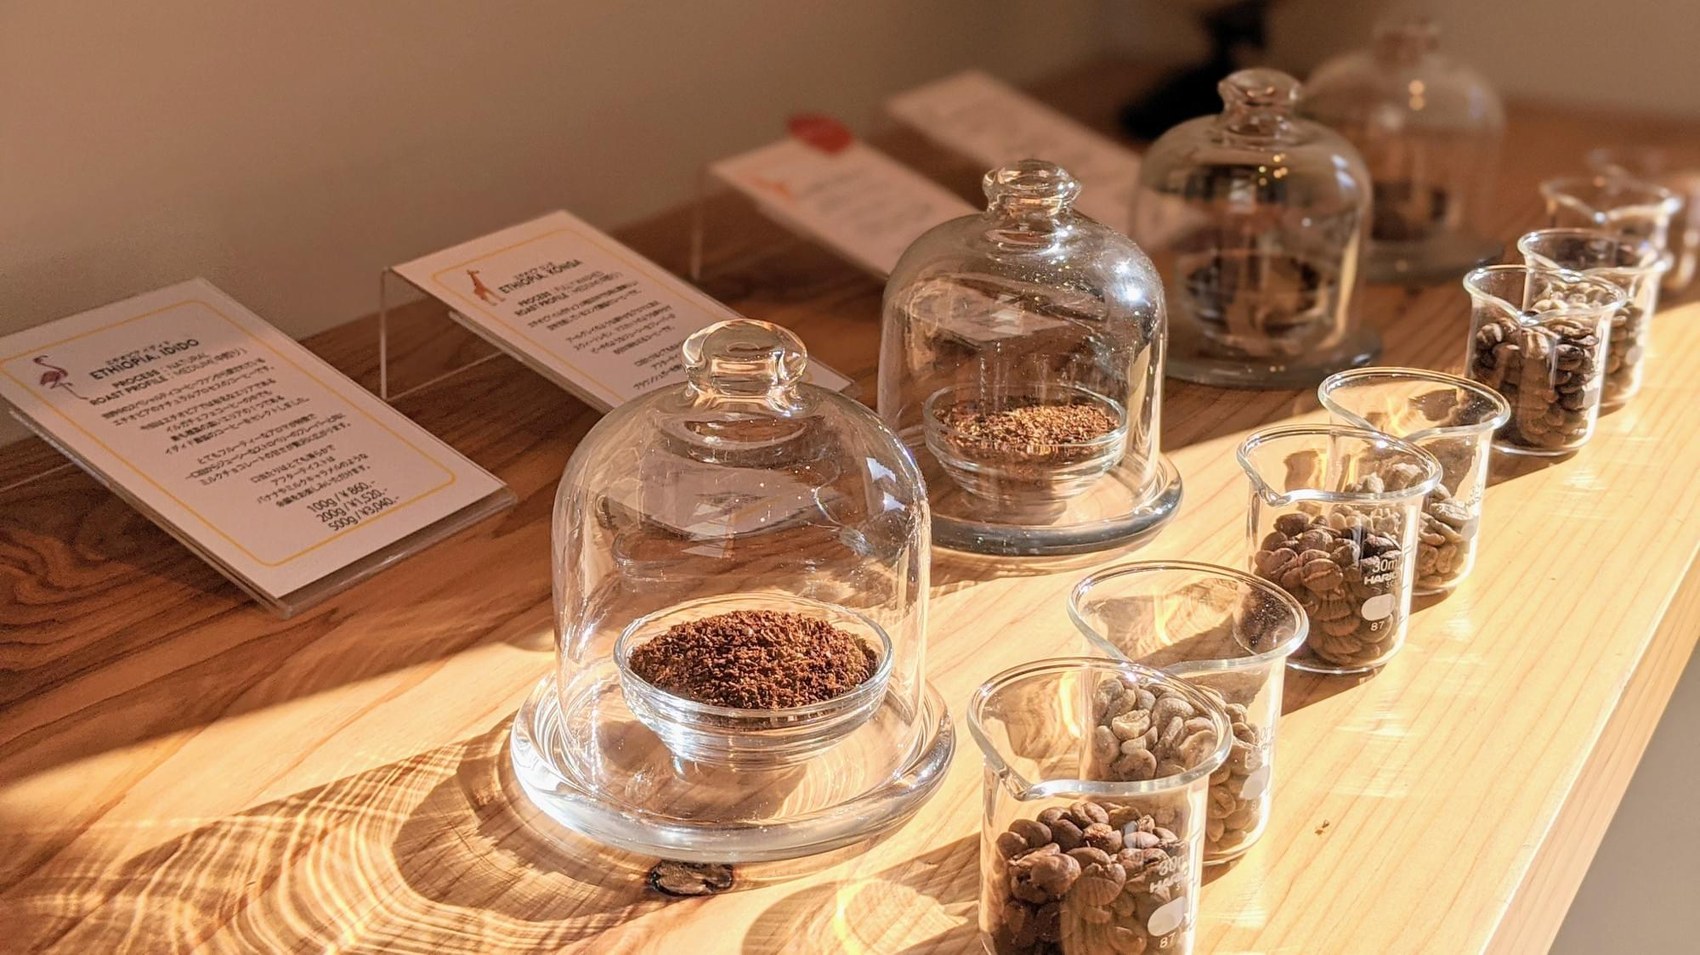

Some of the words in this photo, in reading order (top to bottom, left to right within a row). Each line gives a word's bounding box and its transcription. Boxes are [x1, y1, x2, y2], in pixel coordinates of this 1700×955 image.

[514, 302, 539, 317] ROAST
[538, 292, 569, 306] PROFILE
[518, 292, 552, 307] PROCESS
[158, 339, 200, 356] IDIDO
[112, 369, 160, 388] PROCESS
[166, 353, 209, 370] NATURAL
[90, 390, 124, 406] ROAST
[124, 376, 168, 393] PROFILE
[270, 456, 336, 486] アフターテイストは
[306, 498, 338, 512] 100g
[316, 505, 346, 522] 200g
[328, 514, 358, 531] 500g
[1370, 620, 1385, 632] 87
[1160, 932, 1177, 948] 87
